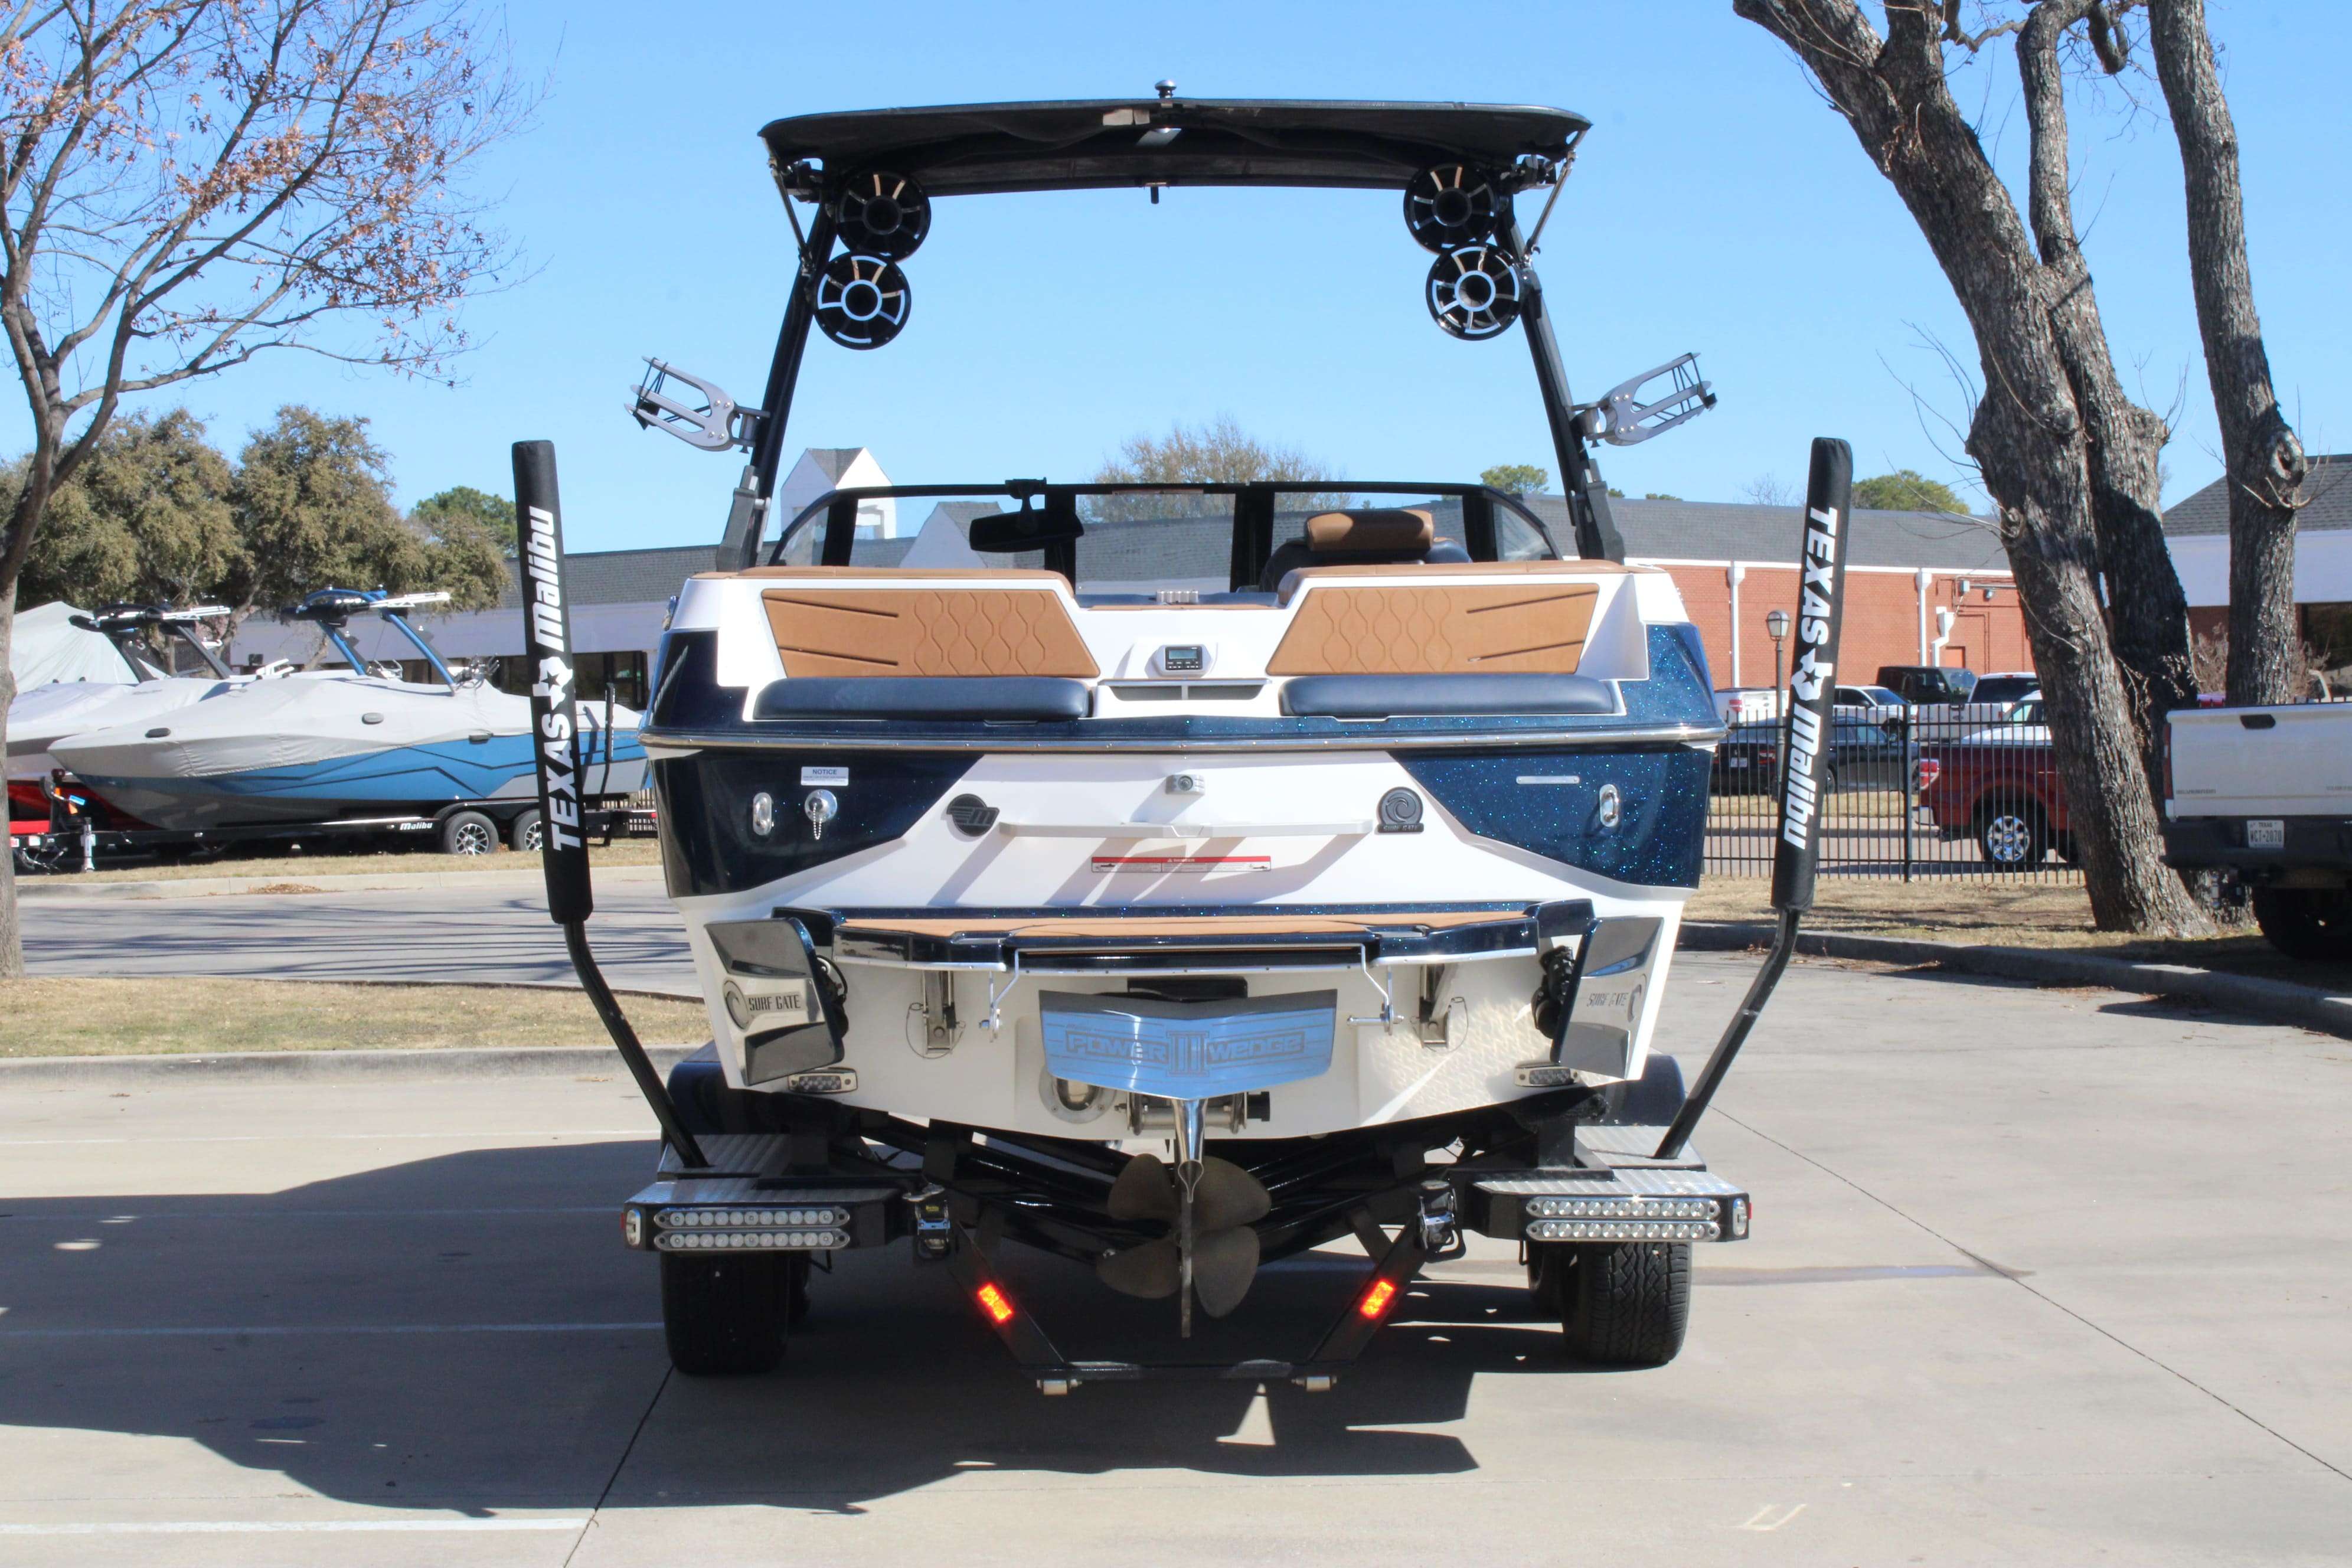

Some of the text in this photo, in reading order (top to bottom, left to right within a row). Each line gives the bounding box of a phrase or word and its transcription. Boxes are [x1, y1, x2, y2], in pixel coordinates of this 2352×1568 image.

[527, 506, 581, 851] TEXAS Malibu
[1783, 507, 1838, 850] TEXAS Malibu
[400, 822, 433, 830] Malibu
[749, 995, 801, 1011] SURF GATE
